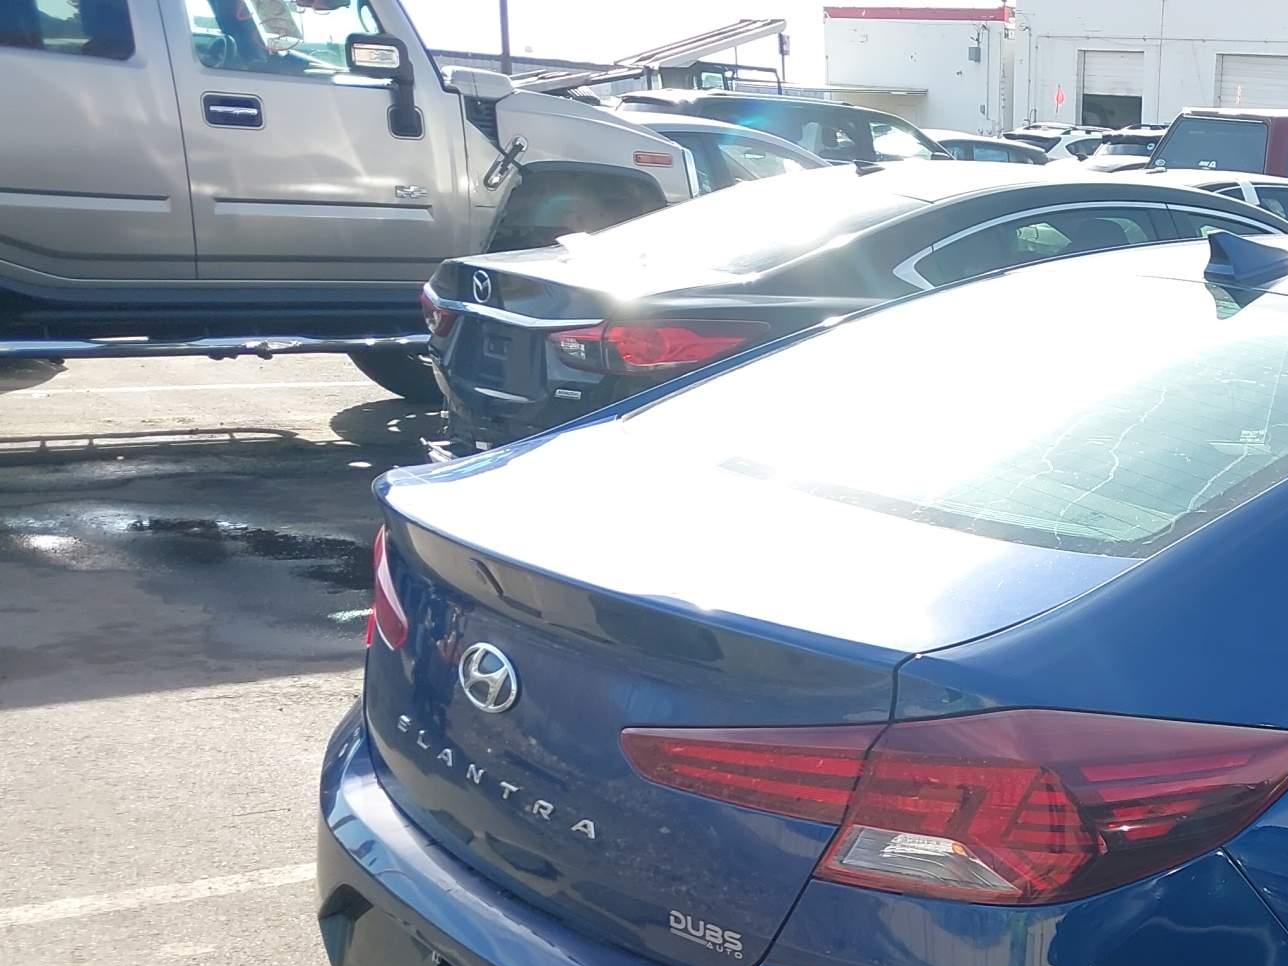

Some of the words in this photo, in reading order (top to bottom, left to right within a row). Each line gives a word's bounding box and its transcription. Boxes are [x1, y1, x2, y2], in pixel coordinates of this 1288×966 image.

[396, 714, 596, 840] ELANTRA
[669, 910, 743, 951] DUBS
[706, 941, 743, 960] AUTO
